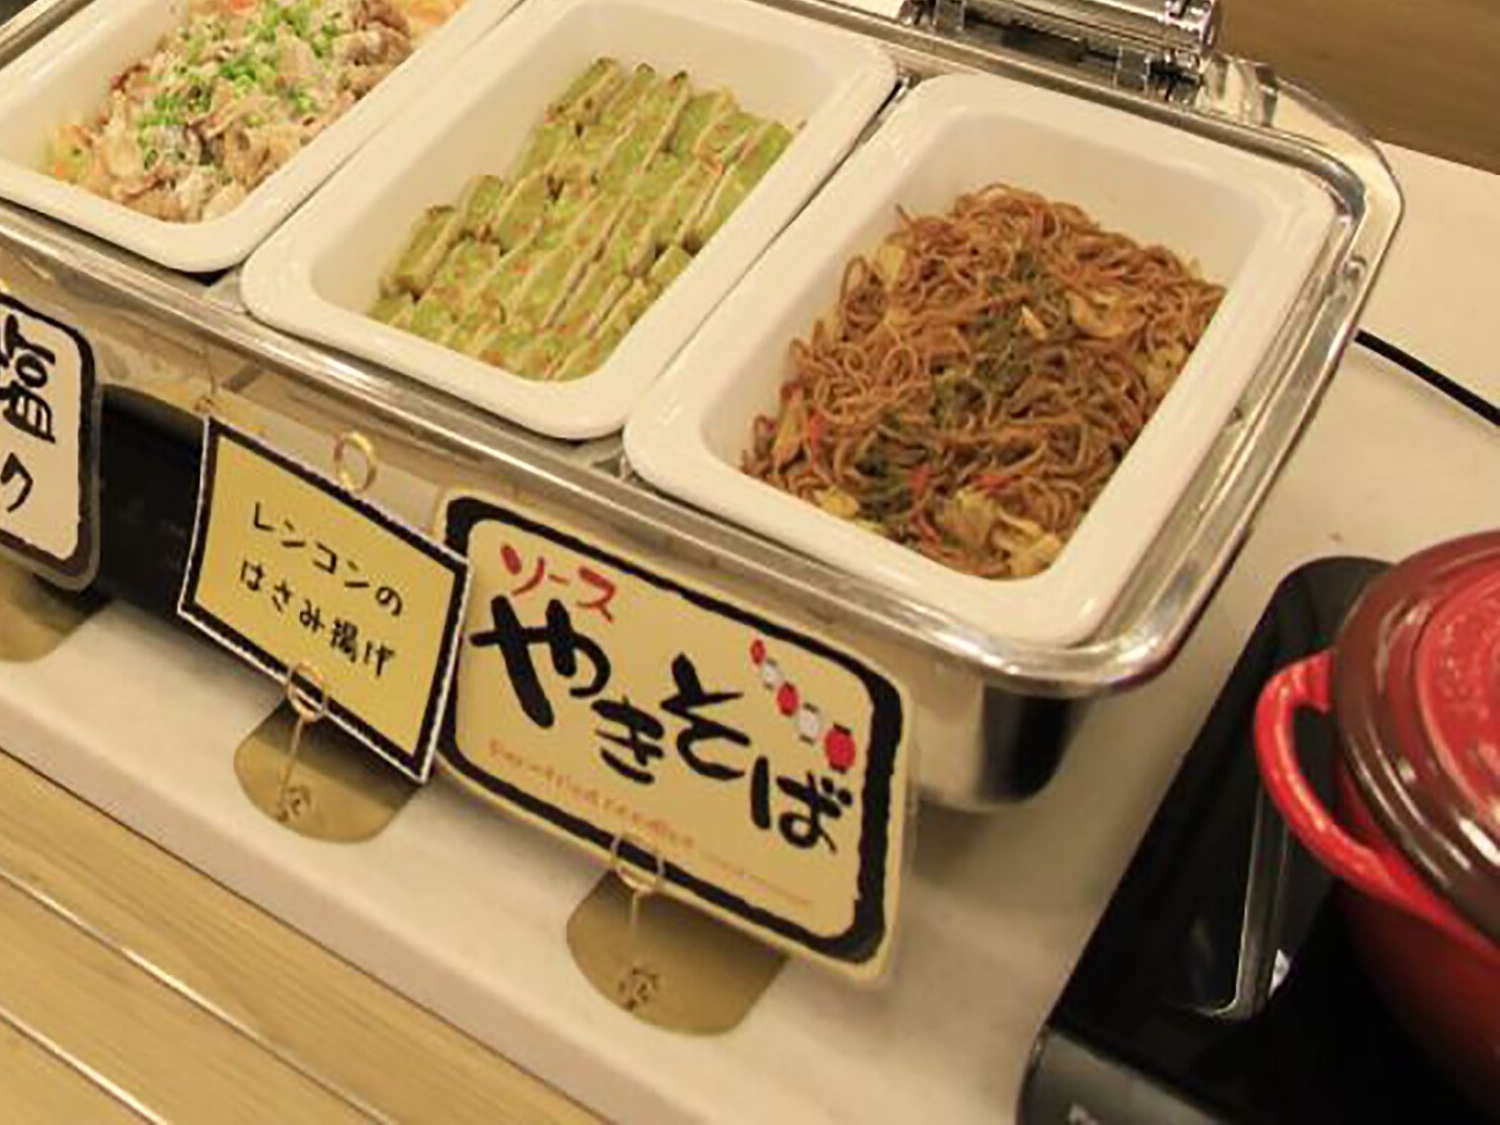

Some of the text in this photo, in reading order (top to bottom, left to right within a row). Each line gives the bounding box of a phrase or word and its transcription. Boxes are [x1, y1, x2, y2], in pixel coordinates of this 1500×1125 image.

[253, 501, 404, 617] レンコンの
[500, 544, 617, 623] ソース
[240, 560, 395, 678] はさみ揚げ
[468, 595, 854, 855] やきそば
